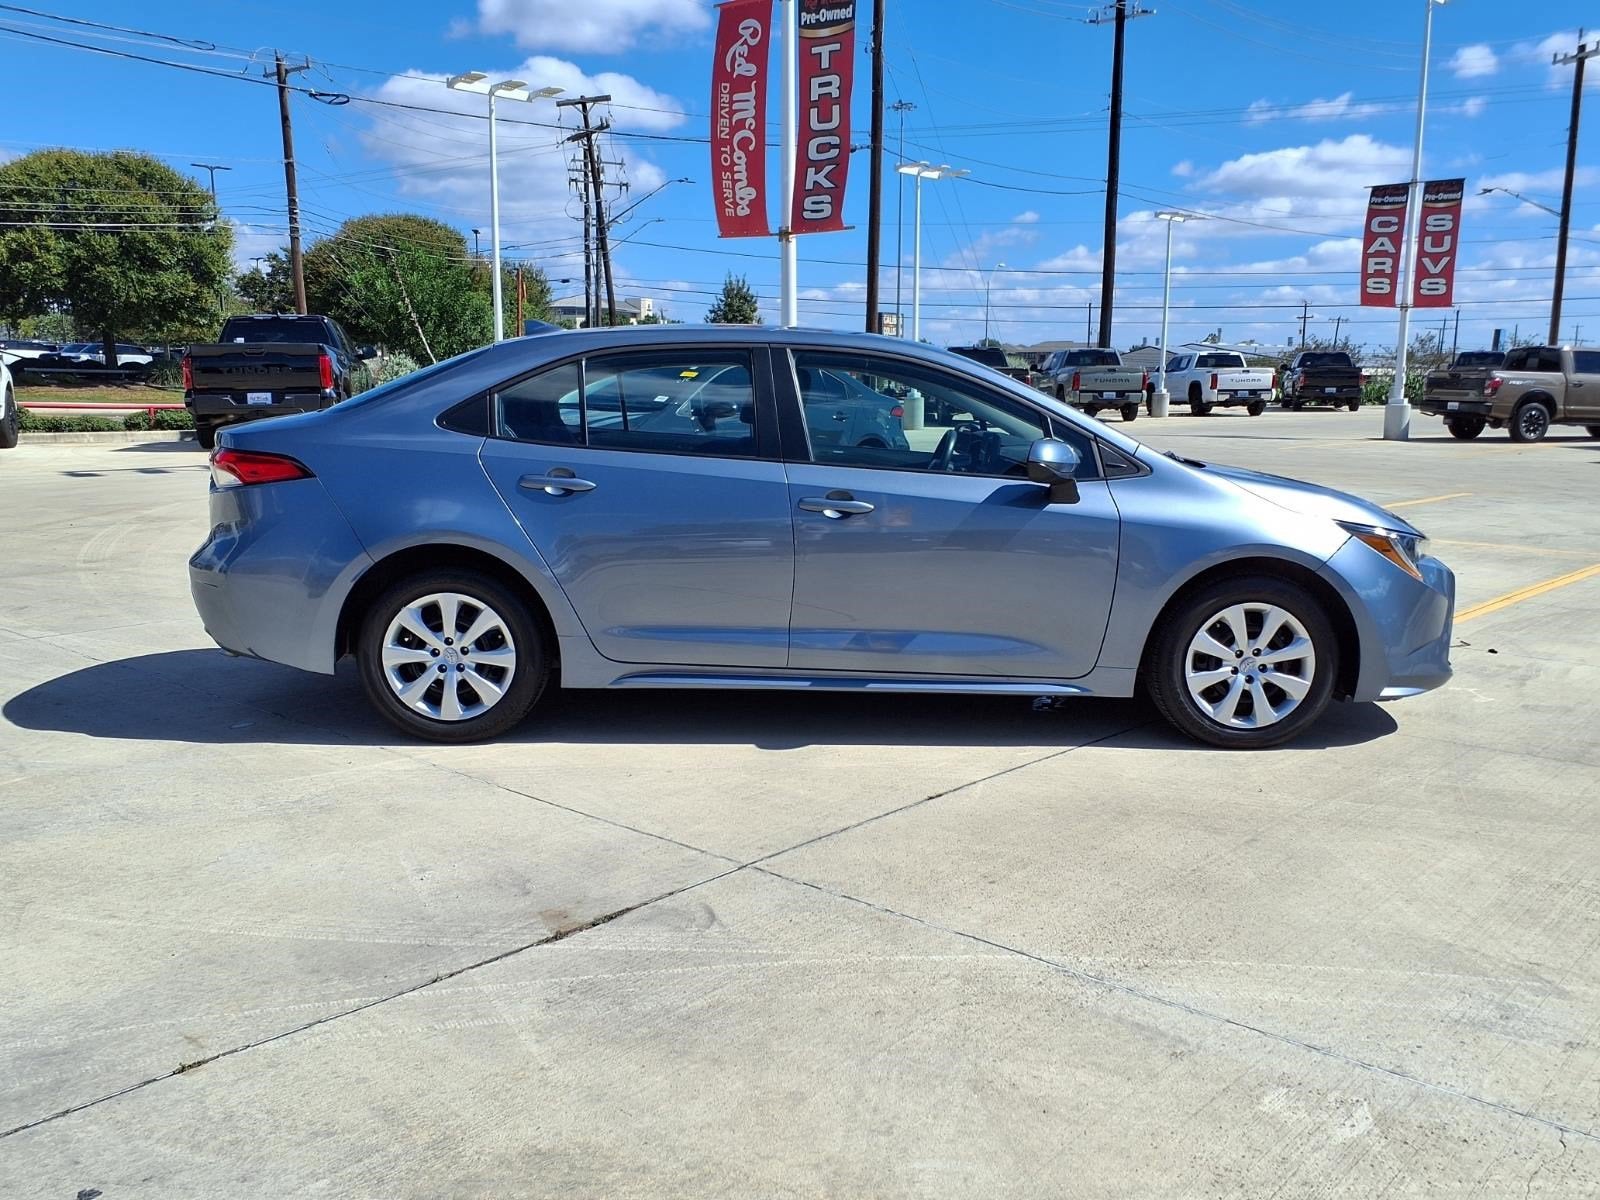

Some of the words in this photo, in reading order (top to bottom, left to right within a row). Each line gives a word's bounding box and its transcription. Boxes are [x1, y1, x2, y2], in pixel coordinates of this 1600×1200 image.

[801, 4, 853, 25] Pre-Owned
[725, 18, 761, 78] Red
[720, 82, 730, 139] DRIVEN
[803, 43, 841, 220] TRUCKS
[720, 145, 731, 165] TO
[722, 172, 735, 217] SERVE
[1366, 216, 1399, 294] CARS
[1420, 214, 1453, 295] SUVS
